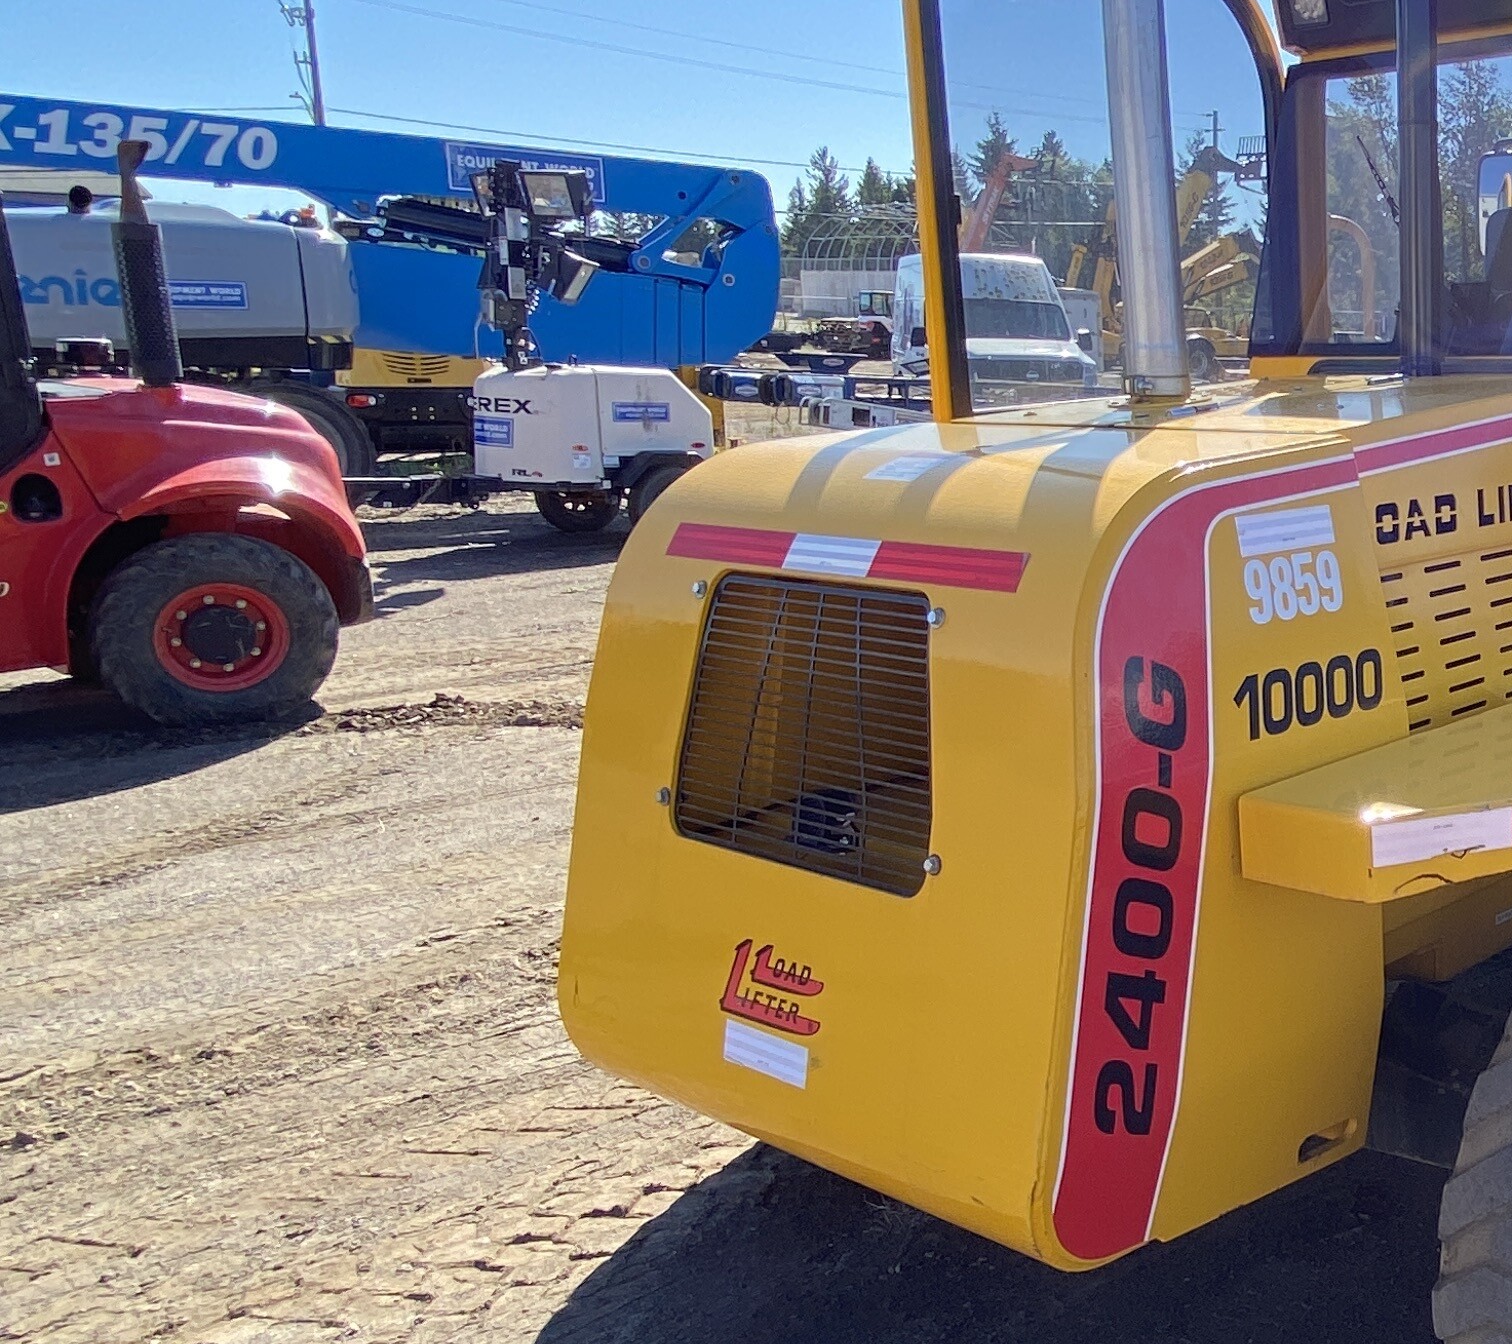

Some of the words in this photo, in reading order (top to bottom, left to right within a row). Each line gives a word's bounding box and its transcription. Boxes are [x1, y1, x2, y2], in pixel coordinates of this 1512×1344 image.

[18, 269, 120, 306] enie
[473, 396, 533, 414] REX
[1375, 493, 1457, 544] OAD
[1244, 550, 1343, 624] 9859
[1233, 648, 1383, 741] 10000
[1094, 655, 1188, 1136] 2400-G
